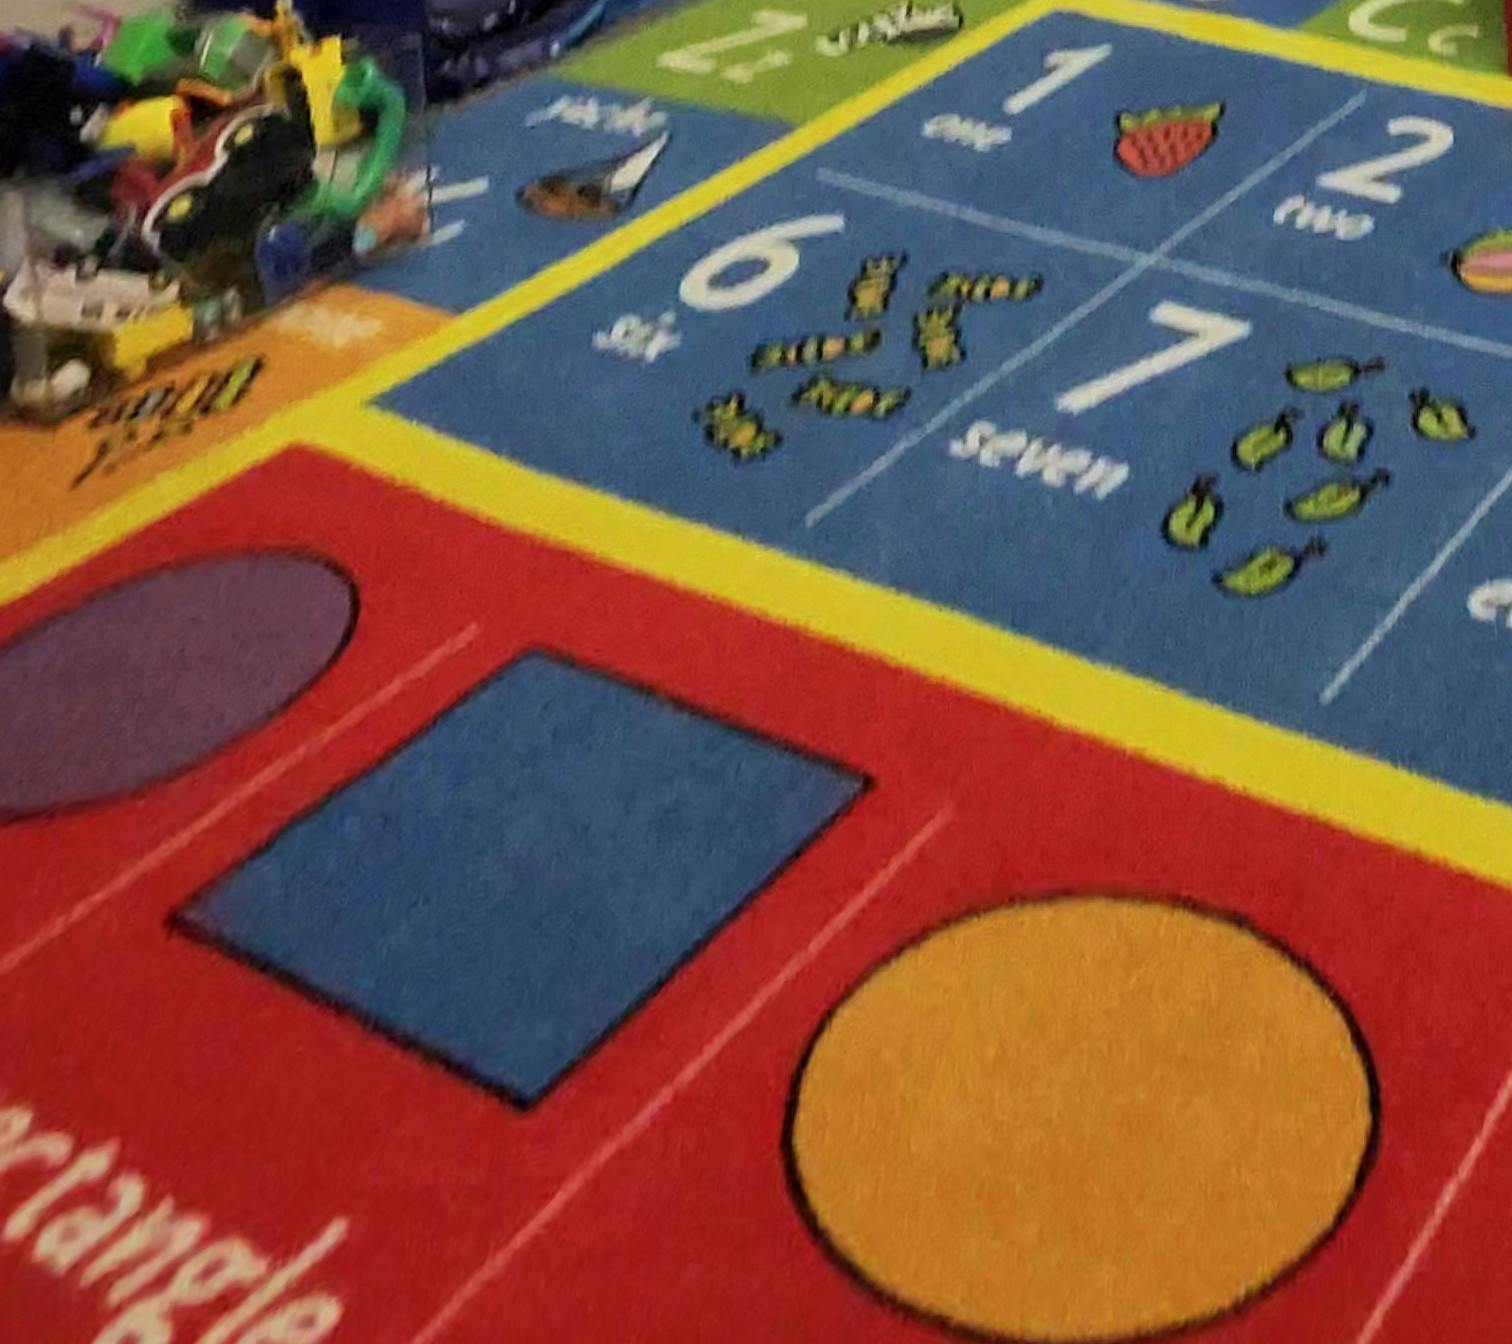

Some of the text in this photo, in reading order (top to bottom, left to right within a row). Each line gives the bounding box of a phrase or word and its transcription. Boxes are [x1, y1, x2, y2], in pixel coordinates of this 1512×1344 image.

[1004, 42, 1113, 115] 1
[1316, 115, 1456, 204] 2
[678, 213, 846, 312] 6
[1055, 299, 1254, 415] 7
[948, 418, 1131, 501] seven
